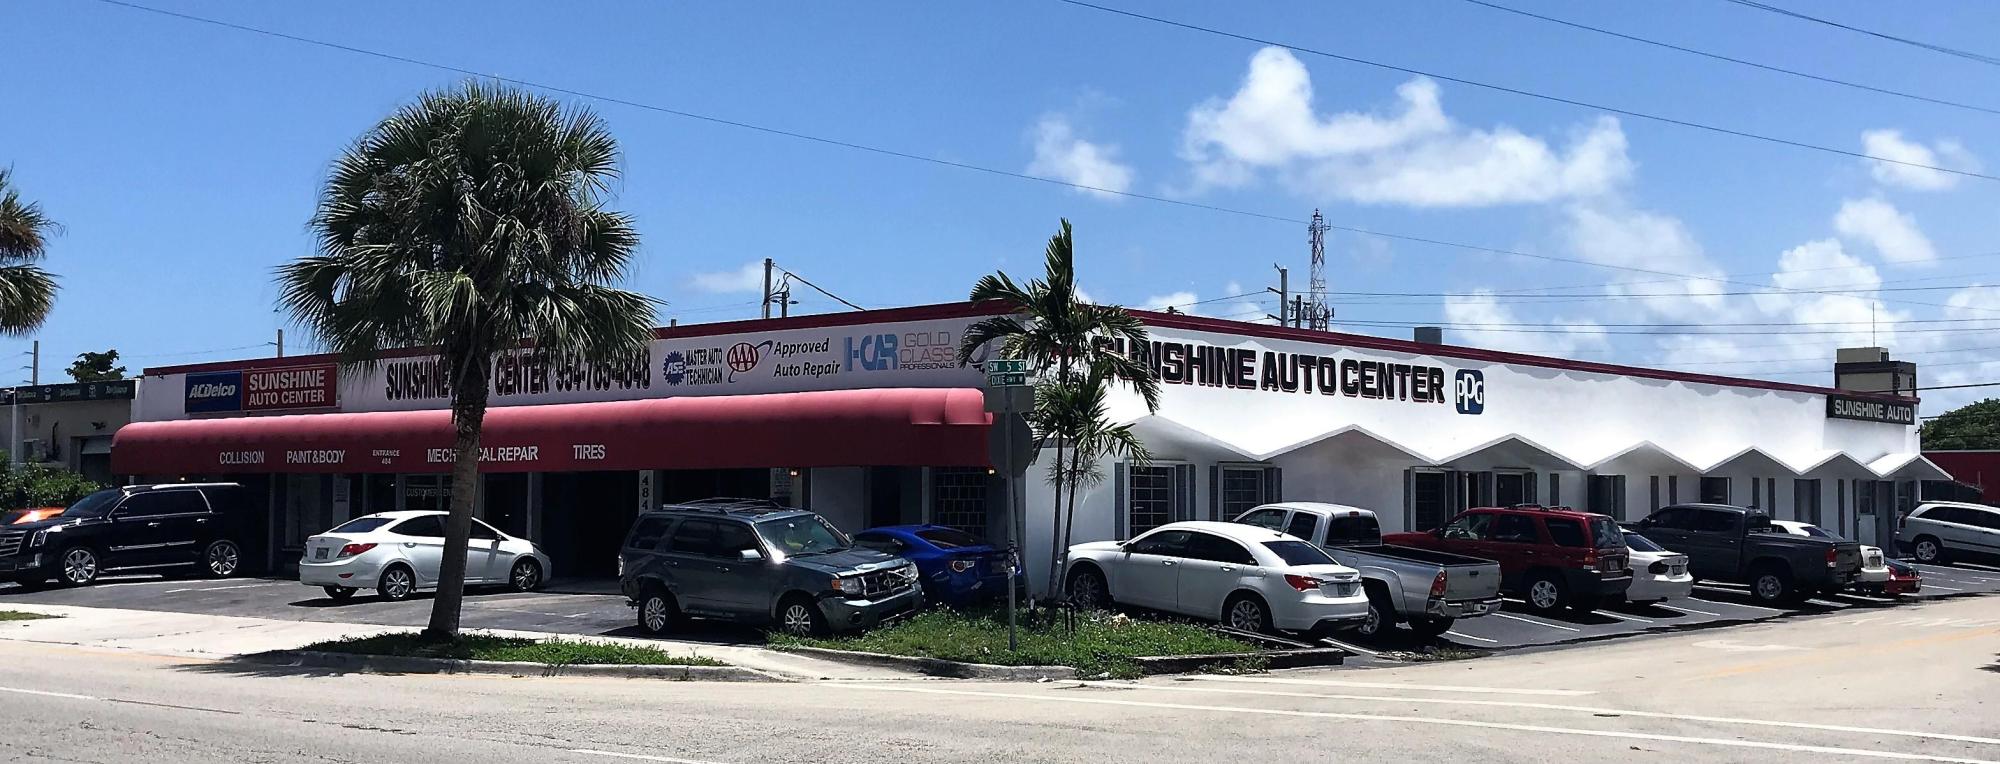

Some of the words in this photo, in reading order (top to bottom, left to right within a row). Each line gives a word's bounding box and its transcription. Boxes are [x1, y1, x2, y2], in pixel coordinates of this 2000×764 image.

[773, 337, 830, 359] Approved
[904, 332, 951, 347] GOLD
[685, 350, 708, 366] MASTER
[708, 347, 723, 364] AUTO
[730, 344, 756, 371] AAA
[844, 334, 898, 371] I-CAR
[900, 347, 955, 363] CLASS
[666, 362, 684, 375] ASE
[773, 363, 800, 377] Auto
[802, 360, 841, 379] Repair
[900, 362, 955, 370] PROFESSIONALS
[989, 361, 999, 372] SW
[1006, 361, 1012, 372] 5
[1017, 361, 1026, 372] ST
[249, 369, 326, 391] SUNSHINE
[685, 367, 723, 386] TECHNICIAN
[1261, 351, 1337, 396] AUTO
[1340, 358, 1446, 404] CENTER
[189, 383, 236, 399] ACDelco
[248, 392, 278, 406] AUTO
[281, 389, 325, 404] CENTER
[1456, 372, 1483, 411] PPG
[1834, 399, 1884, 419] SUNSHINE
[1886, 405, 1911, 422] AUTO
[219, 450, 265, 465] COLLISION
[286, 449, 346, 464] PAINT&BODY
[372, 449, 400, 457] ENTRANCE
[498, 445, 538, 462] REPAIR
[573, 444, 606, 460] TIRES
